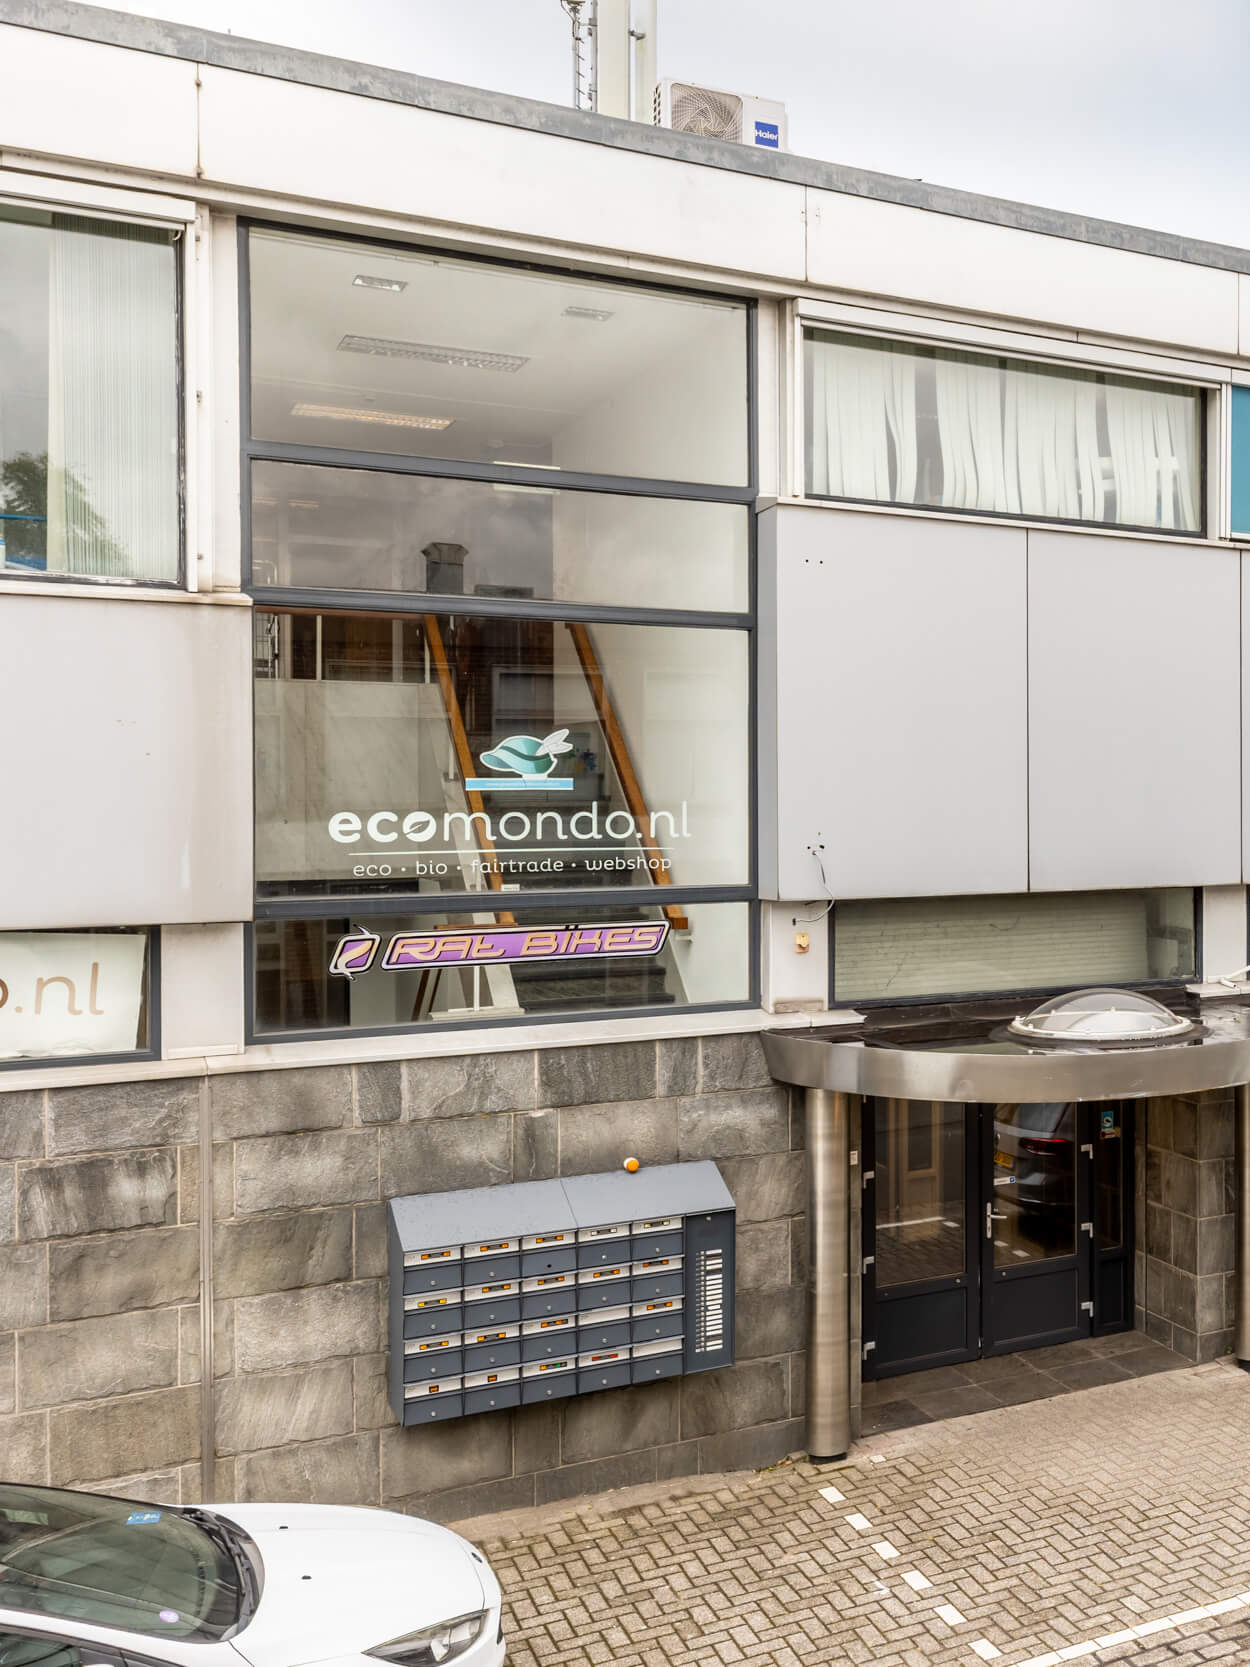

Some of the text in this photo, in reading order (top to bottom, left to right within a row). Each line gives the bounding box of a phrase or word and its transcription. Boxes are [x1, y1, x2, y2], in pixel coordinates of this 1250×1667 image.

[753, 129, 778, 140] Haier
[328, 800, 692, 843] ecomondo.nl
[352, 855, 672, 877] eco bio fairtrade webshop
[0, 961, 105, 1016] .nl
